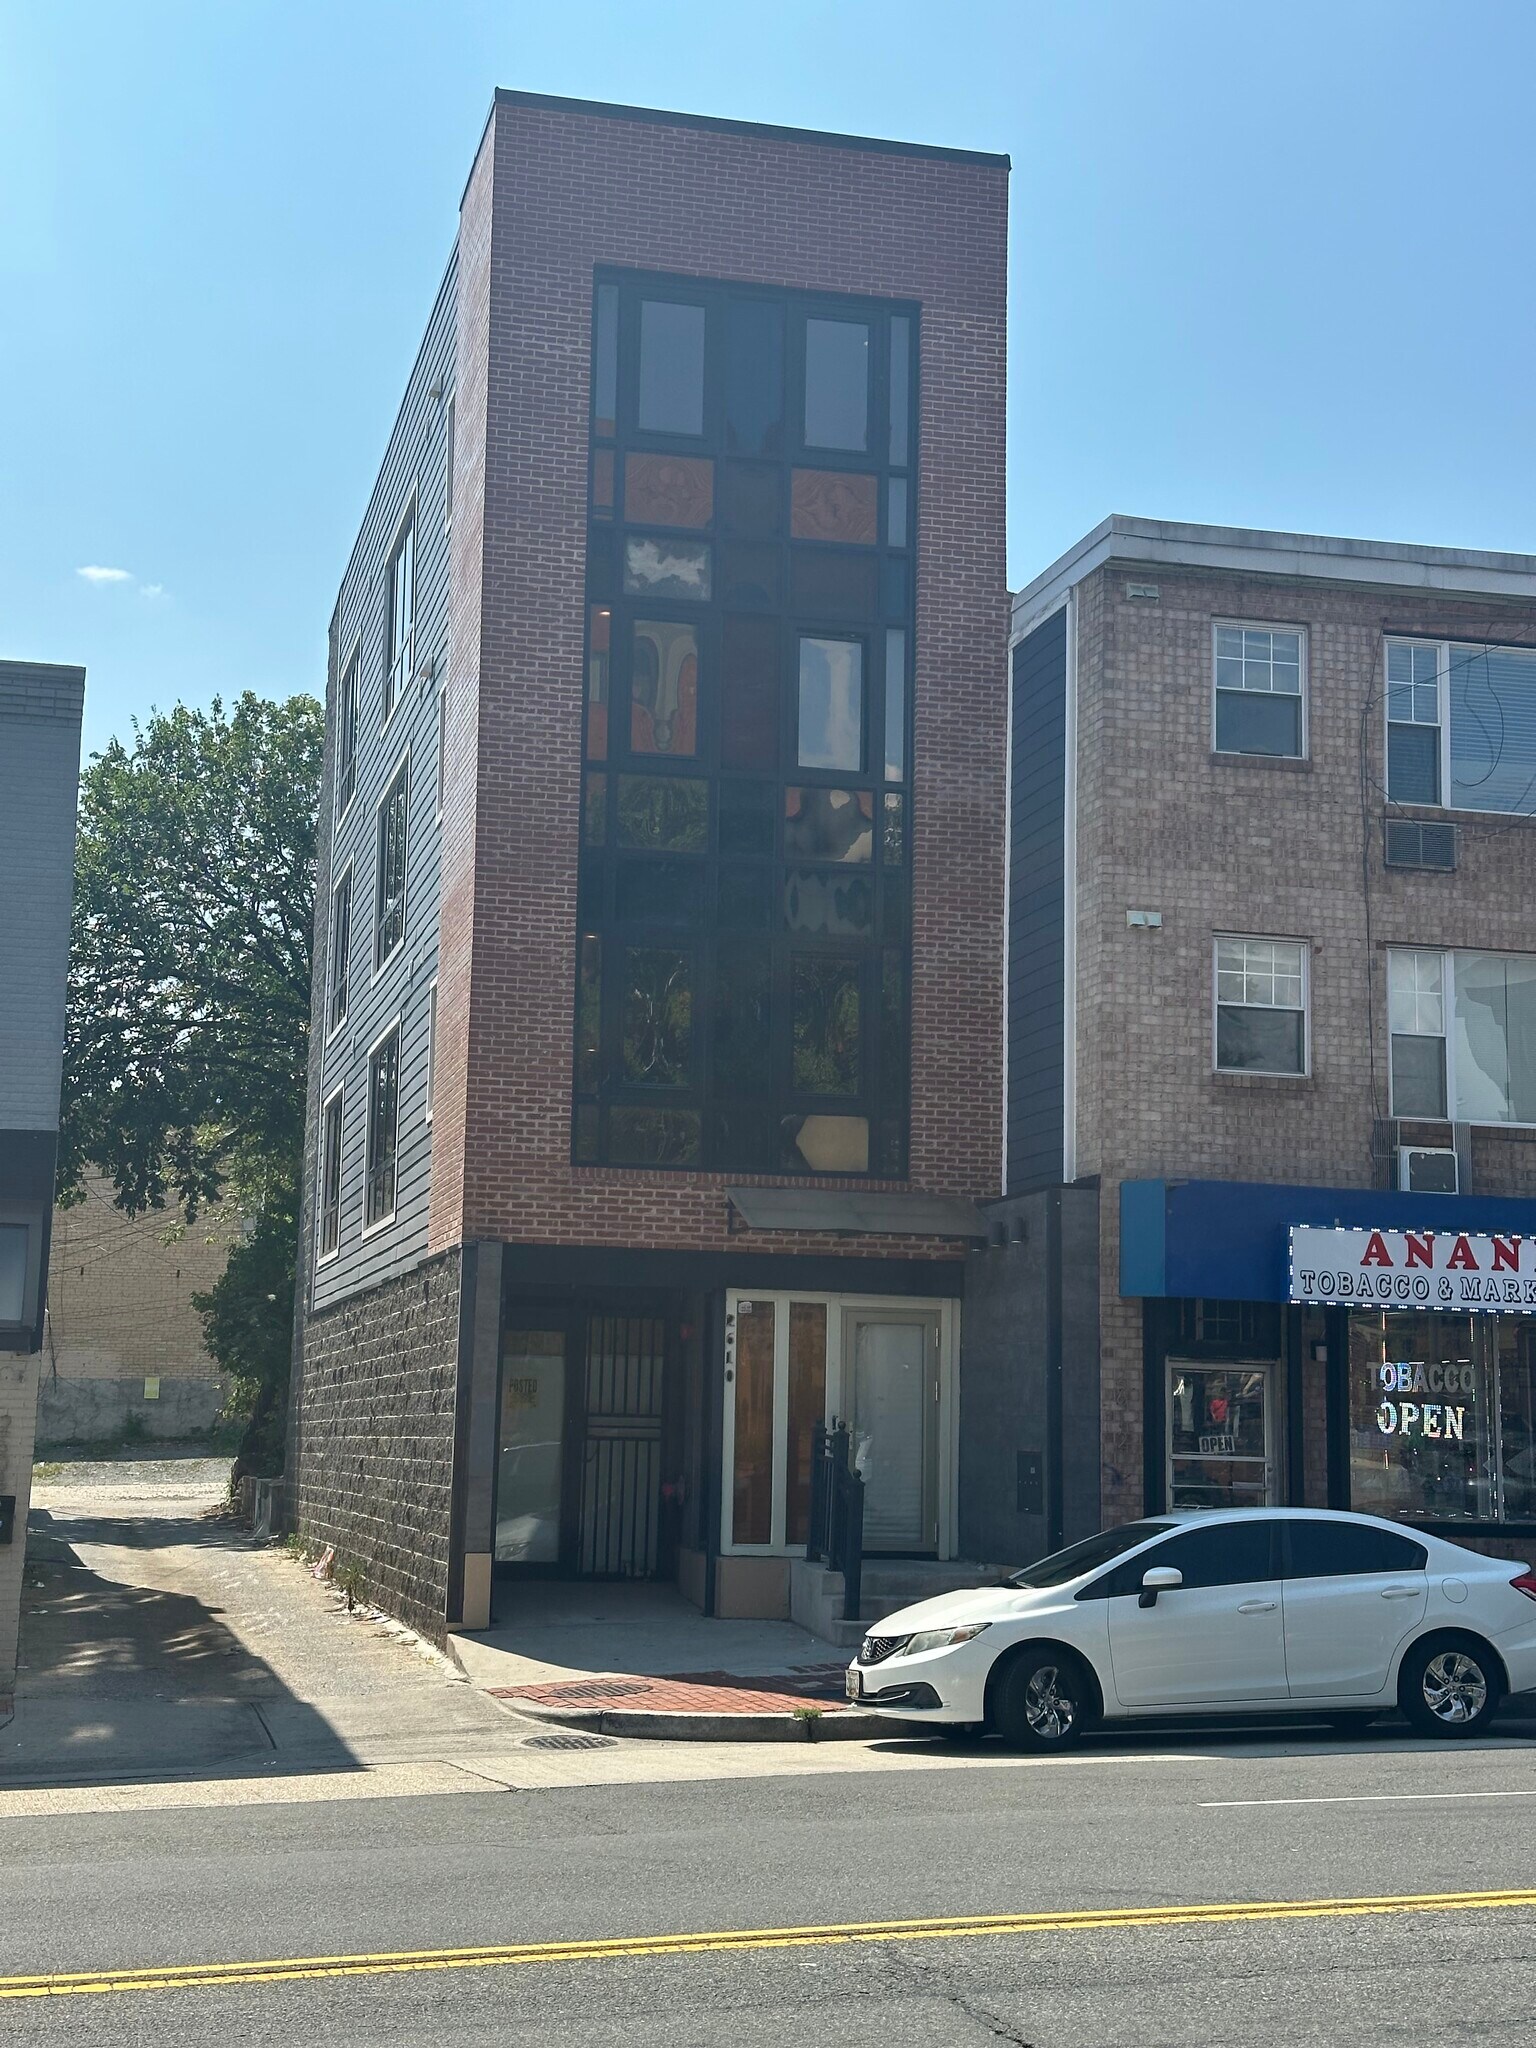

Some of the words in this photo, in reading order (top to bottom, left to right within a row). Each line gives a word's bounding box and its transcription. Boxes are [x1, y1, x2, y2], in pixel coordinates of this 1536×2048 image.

[1360, 1231, 1536, 1273] ANAN
[1300, 1269, 1430, 1300] TOBACCO
[1437, 1276, 1453, 1300] &
[726, 1313, 735, 1382] 2610
[1366, 1361, 1476, 1394] TOBACCO
[1376, 1401, 1465, 1440] OPEN
[1200, 1436, 1234, 1453] OPEN
